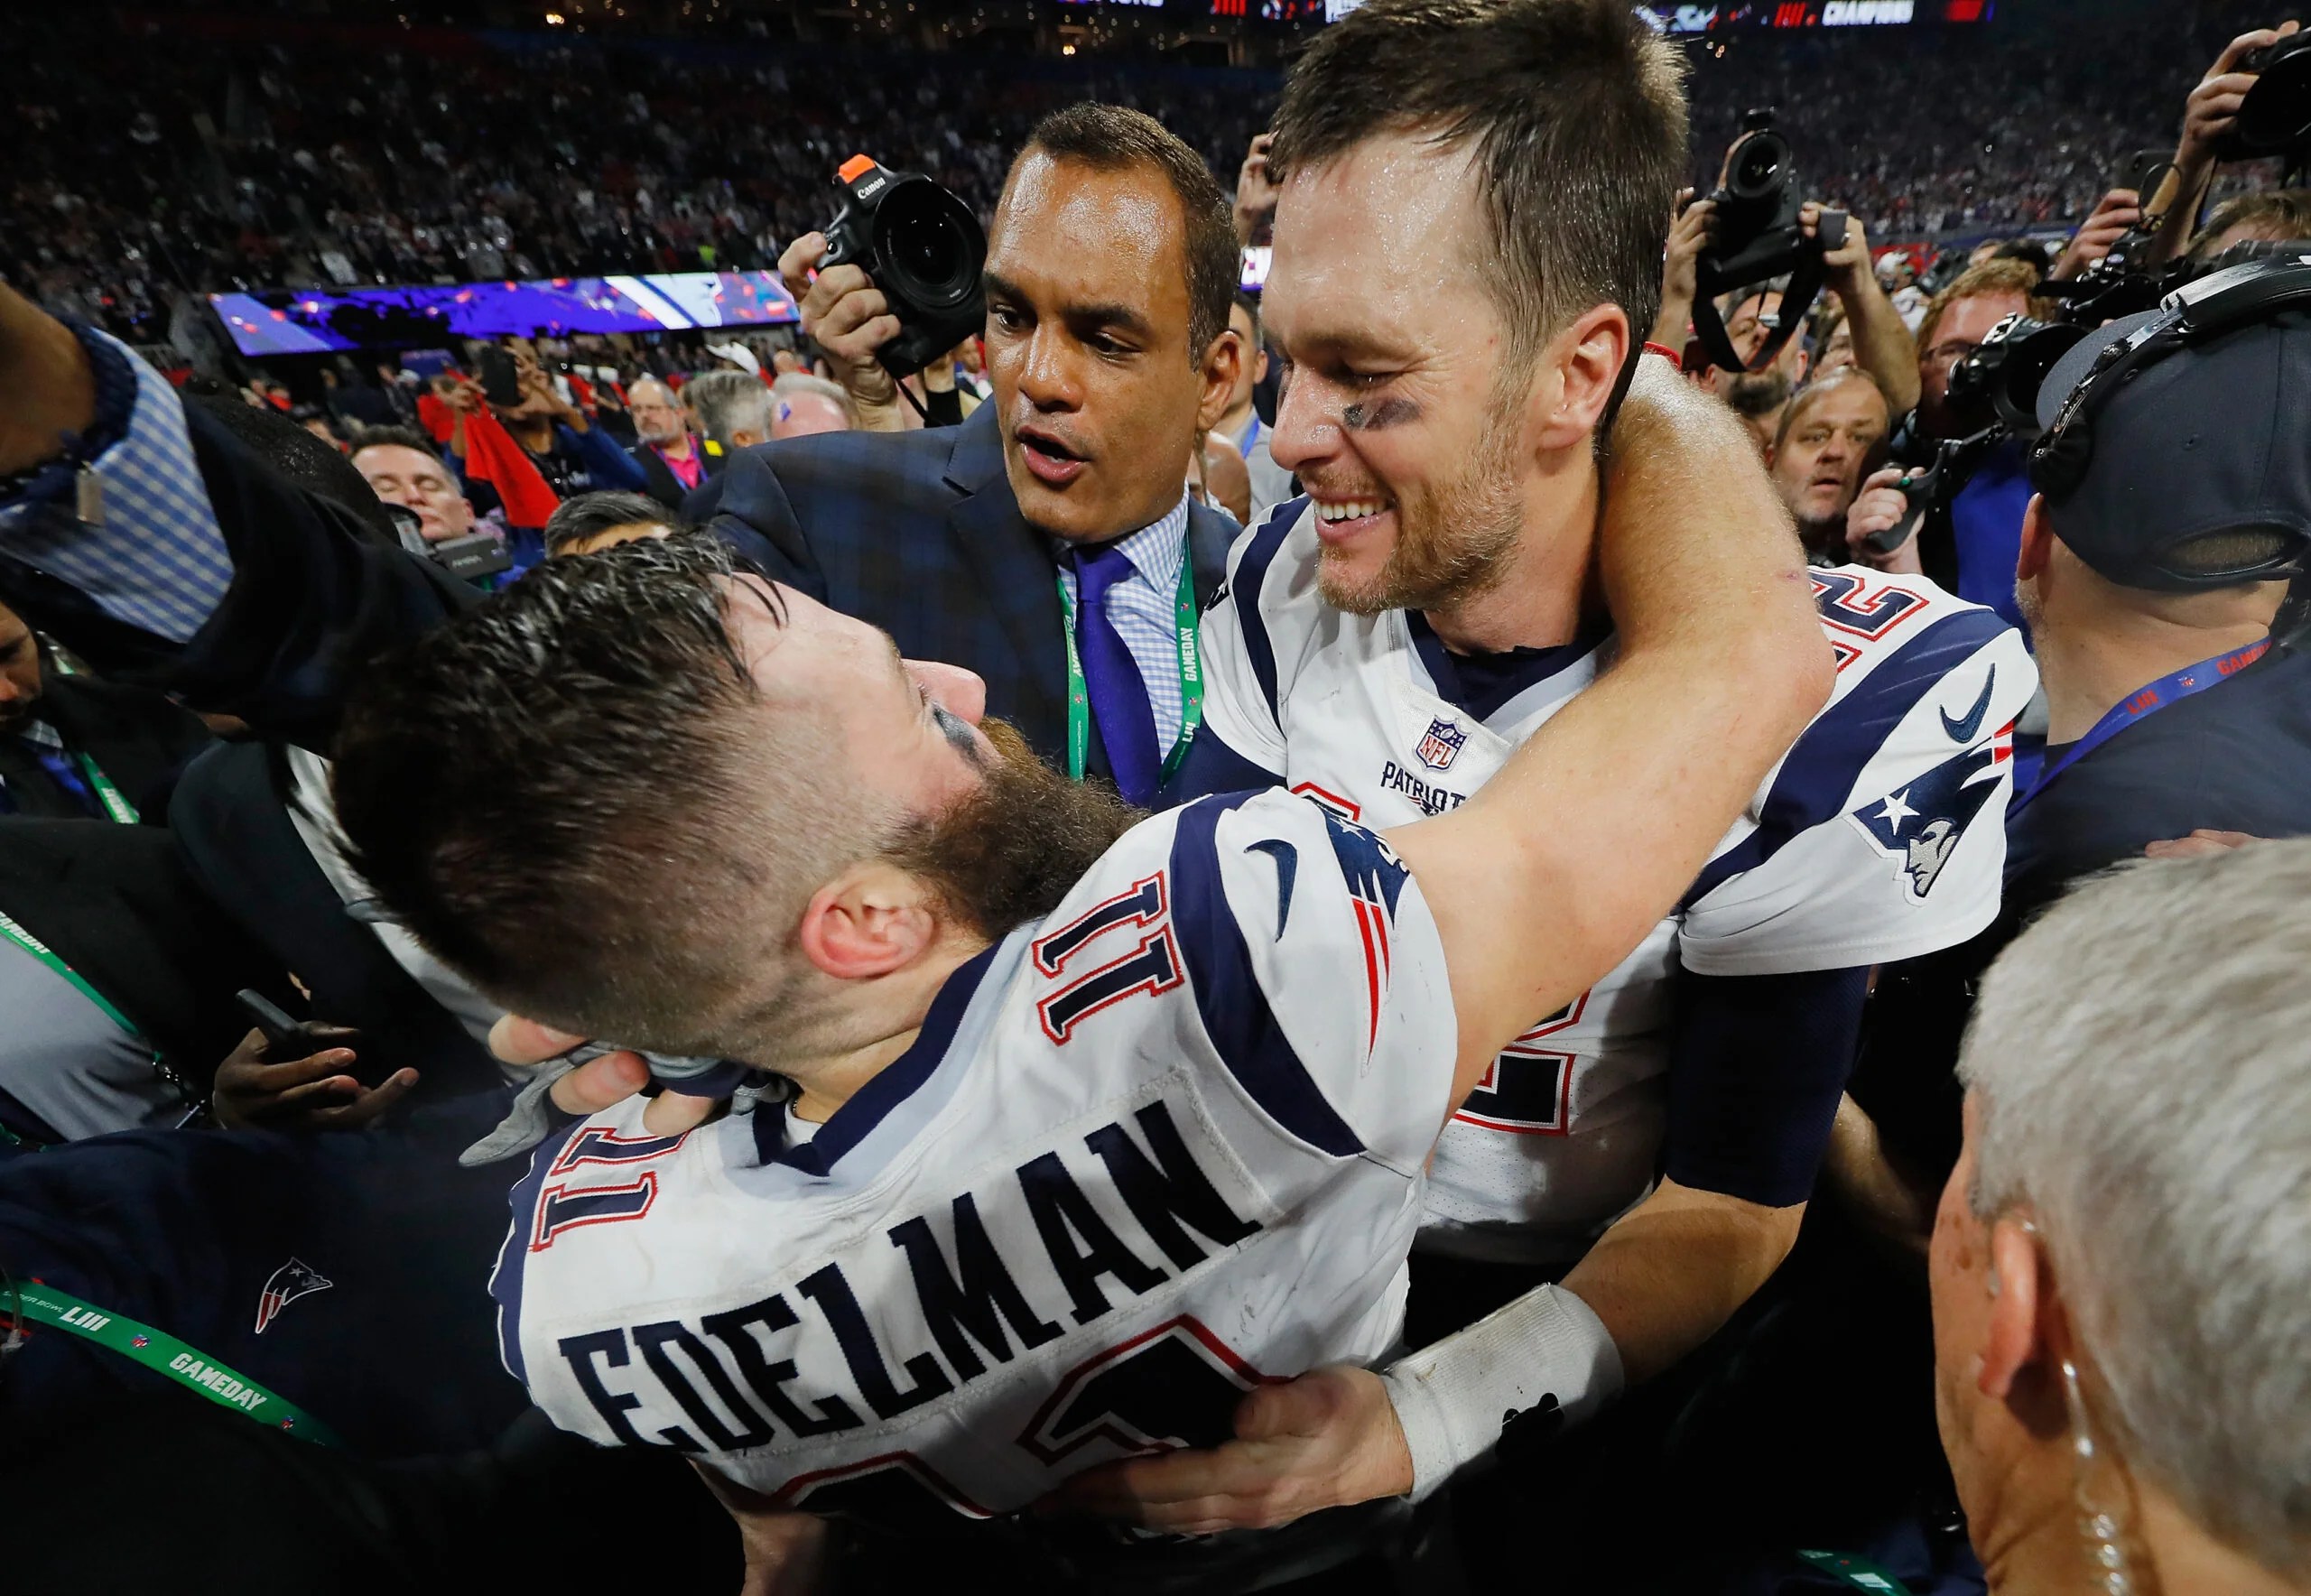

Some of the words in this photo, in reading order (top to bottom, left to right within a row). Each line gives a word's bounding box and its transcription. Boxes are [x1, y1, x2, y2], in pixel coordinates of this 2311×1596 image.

[857, 177, 886, 200] Canon
[1180, 627, 1198, 682] GAMEDAY
[1420, 735, 1452, 766] NFL
[1380, 760, 1467, 812] PATRIOT
[1031, 869, 1185, 1047] 11
[528, 1127, 693, 1252] 11
[560, 1100, 1263, 1452] EDELMAN
[59, 1306, 111, 1332] LIII
[170, 1352, 267, 1411] GAMEDAY
